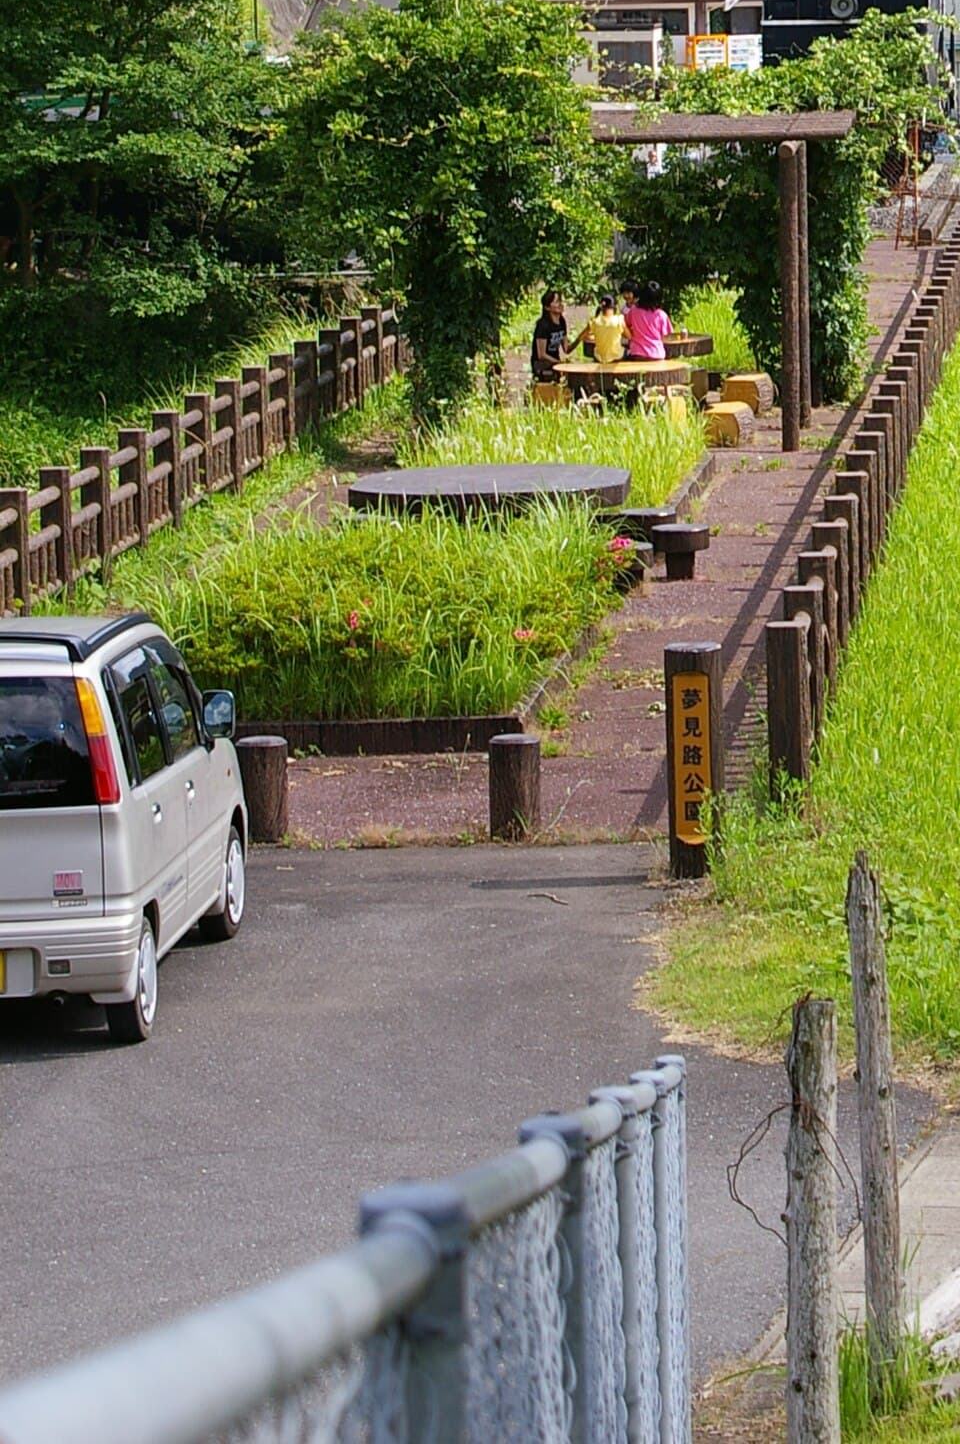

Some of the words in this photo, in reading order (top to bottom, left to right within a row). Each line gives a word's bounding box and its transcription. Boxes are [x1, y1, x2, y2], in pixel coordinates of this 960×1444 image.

[681, 688, 704, 822] 夢見路公園
